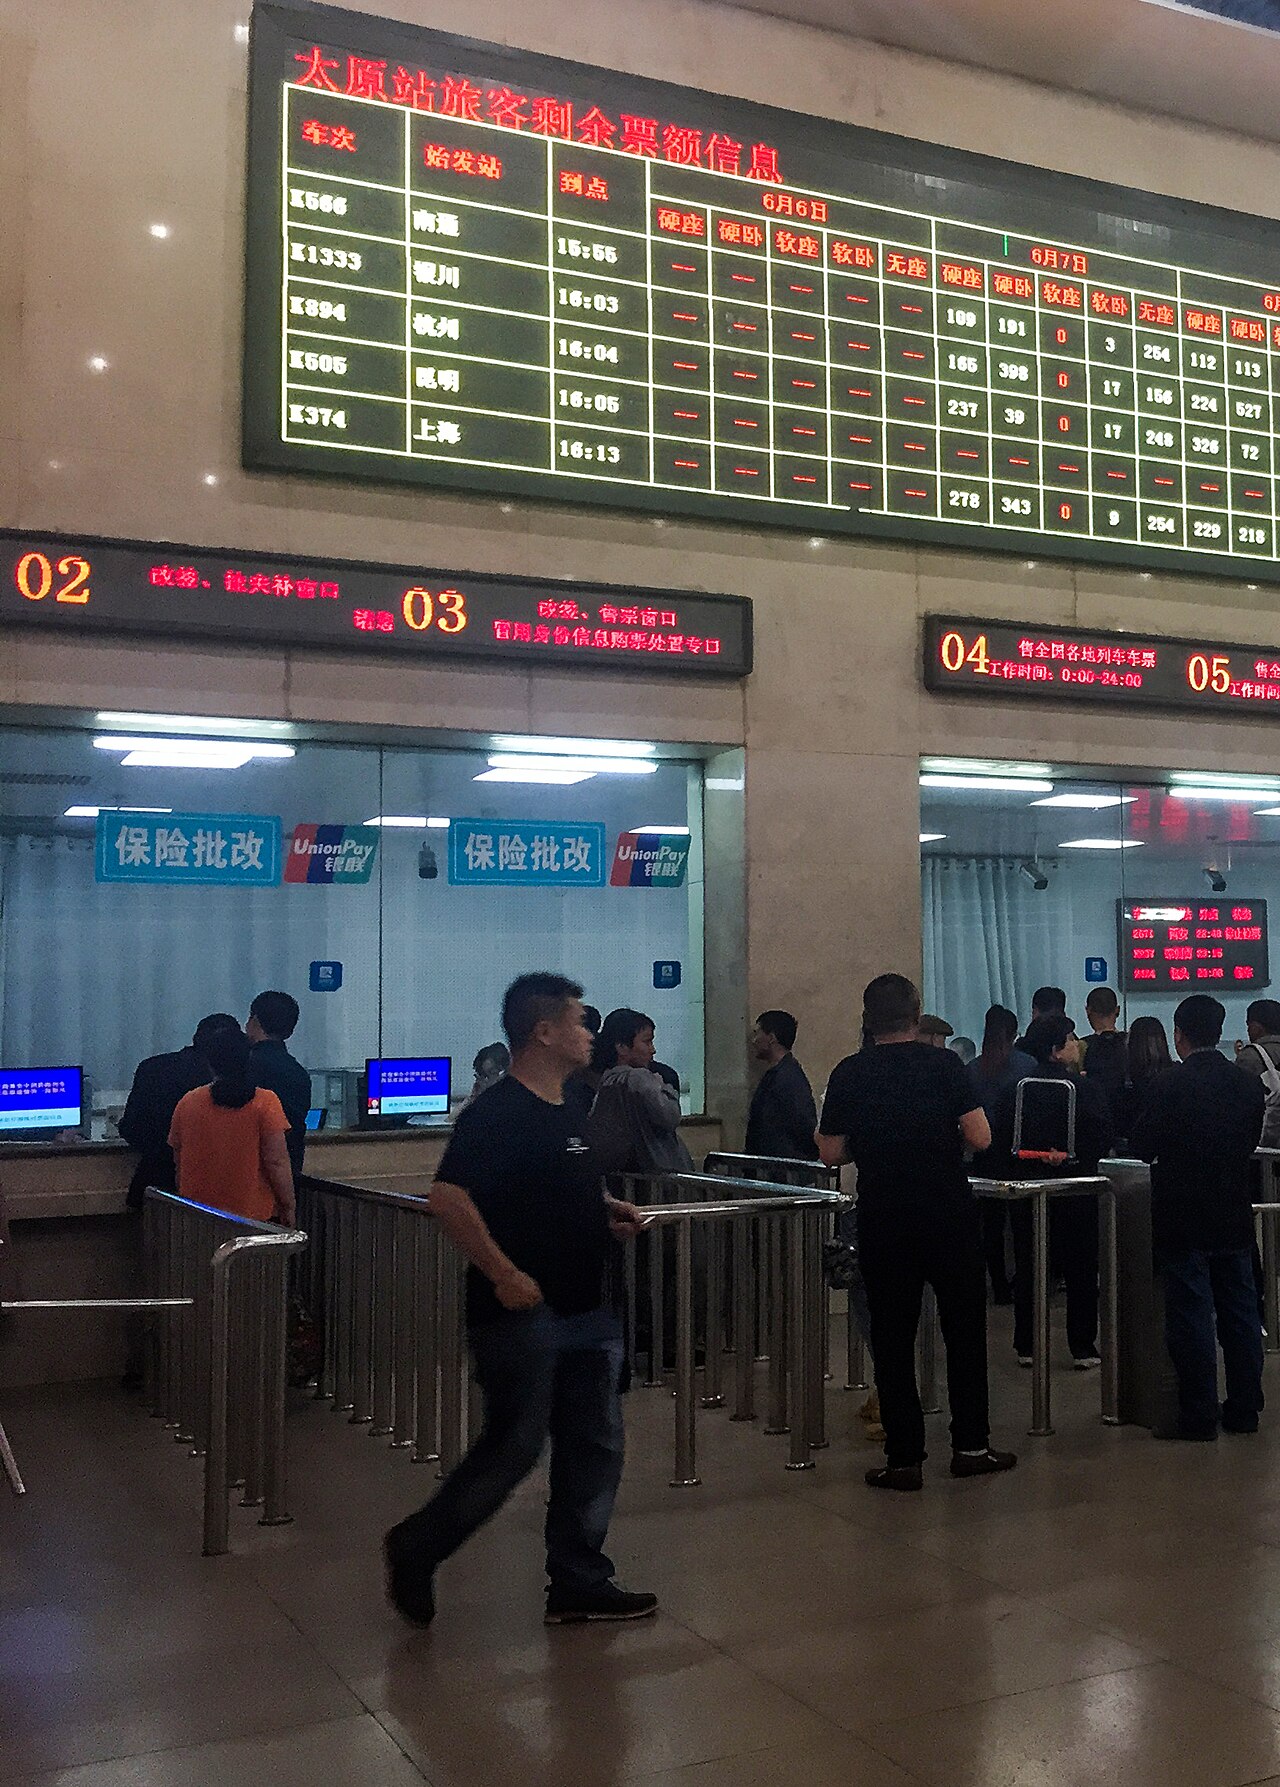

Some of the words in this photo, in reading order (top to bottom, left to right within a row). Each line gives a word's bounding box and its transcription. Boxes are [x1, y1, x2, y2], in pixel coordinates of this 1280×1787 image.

[294, 46, 784, 183] 太原站旅客剩余票额信息
[302, 120, 356, 152] 车次
[424, 143, 502, 179] 始发站
[559, 171, 608, 201] 到点
[762, 192, 828, 222] 6月6日
[657, 208, 704, 236] 硬座
[718, 220, 764, 246] 硬卧
[775, 230, 818, 258] 软座
[832, 241, 874, 268] 软卧
[887, 253, 927, 278] 无座
[941, 263, 982, 289] 硬座
[993, 273, 1033, 297] 硬卧
[1042, 281, 1081, 307] 软座
[1091, 292, 1128, 316] 软卧
[1139, 302, 1174, 325] 无座
[1186, 310, 1220, 333] 硬座
[1230, 318, 1265, 341] 硬卧
[1032, 247, 1086, 273] 6月7日
[291, 243, 361, 270] K1333
[559, 288, 618, 313] 16:03
[1104, 380, 1120, 396] 17
[558, 238, 617, 263] 15:55
[999, 318, 1026, 336] 191
[1144, 344, 1170, 362] 254
[290, 296, 346, 321] K894
[559, 339, 618, 363] 16:04
[948, 400, 978, 417] 237
[1005, 408, 1024, 424] 39
[1105, 424, 1121, 439] 17
[1146, 430, 1173, 447] 248
[559, 390, 619, 413] 16:05
[289, 404, 346, 428] K374
[413, 418, 461, 444] 上海
[560, 440, 619, 463] 16:13
[950, 491, 979, 508] 278
[1002, 497, 1031, 514] 343
[1148, 516, 1175, 533] 254
[18, 554, 90, 603] 02
[403, 588, 466, 632] 03
[941, 632, 990, 673] 04
[1018, 638, 1156, 668] 售全国各地列车车票
[1188, 656, 1231, 693] 05
[115, 825, 263, 871] 保险批改
[293, 840, 374, 859] UnionPay
[324, 857, 366, 874] 银联
[464, 829, 592, 873] 保险批改
[619, 847, 686, 863] UnionPay
[644, 861, 678, 878] 银联
